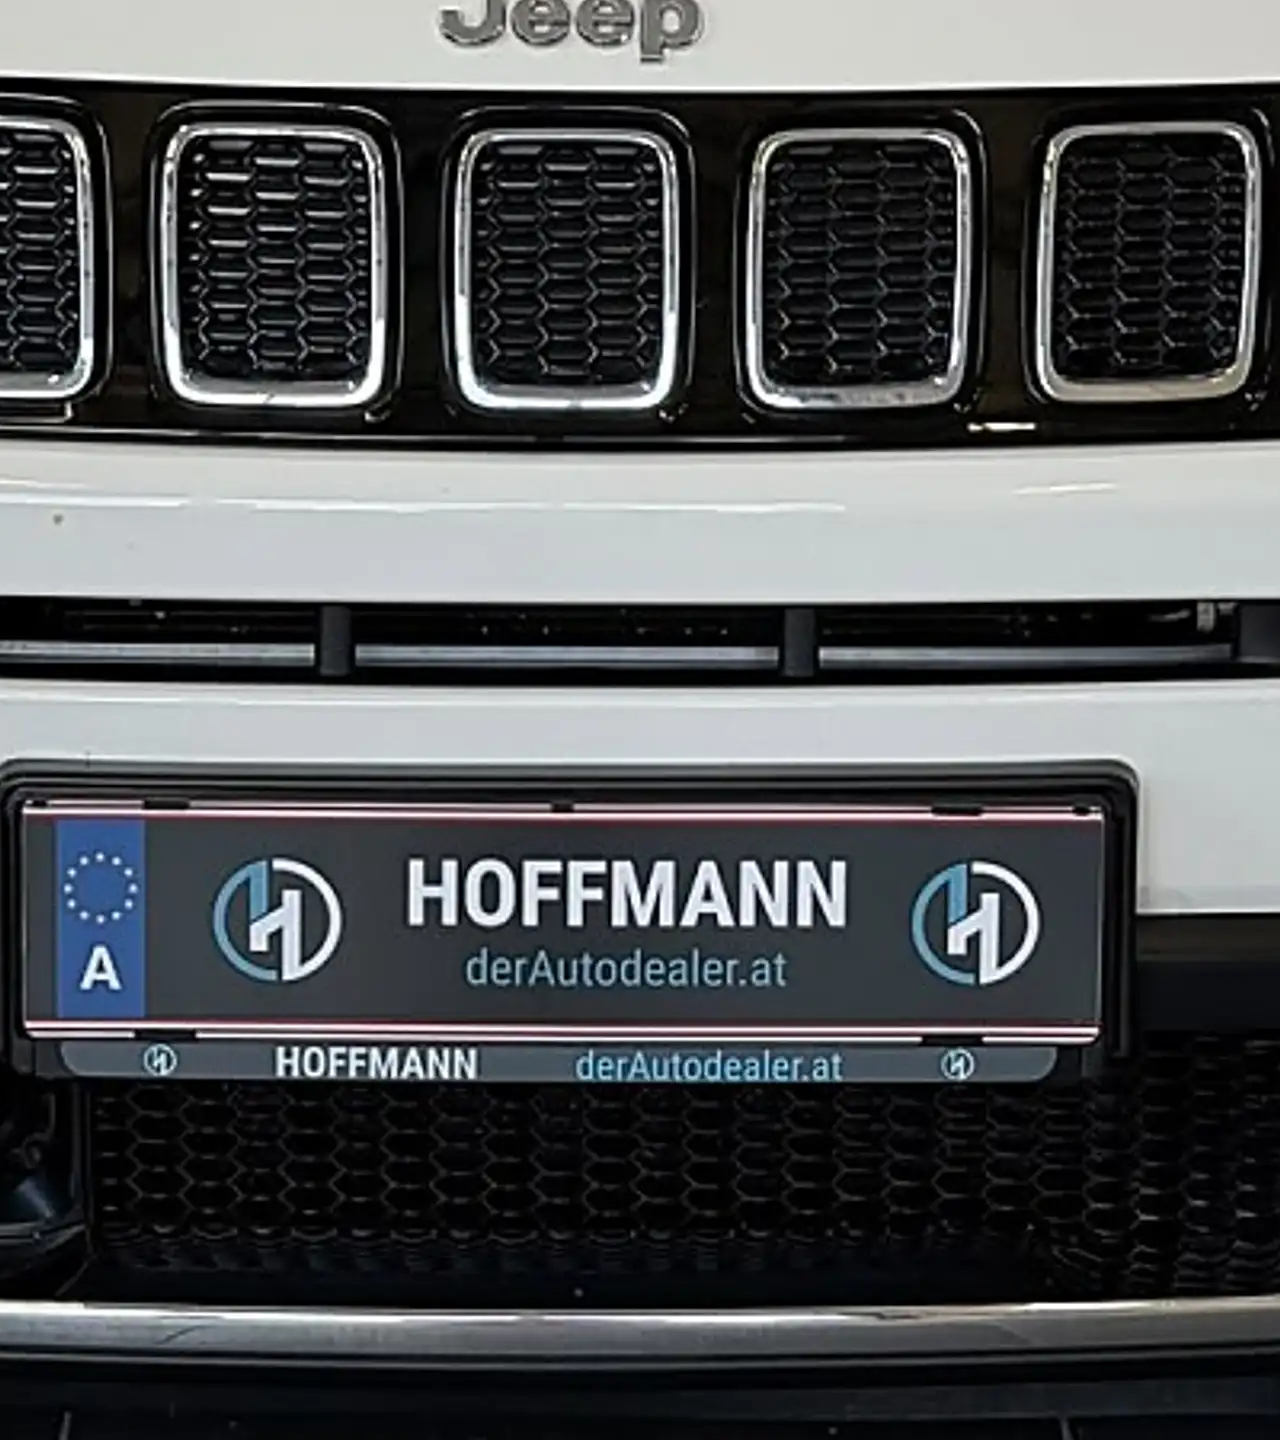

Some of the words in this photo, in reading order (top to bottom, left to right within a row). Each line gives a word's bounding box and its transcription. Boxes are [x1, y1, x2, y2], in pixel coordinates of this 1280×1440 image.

[407, 858, 848, 928] HOFFMANN
[79, 946, 121, 990] A
[465, 950, 787, 989] derAutodealer.at
[275, 1046, 478, 1080] HOFFMANN
[575, 1049, 843, 1082] derAutodealer.at
